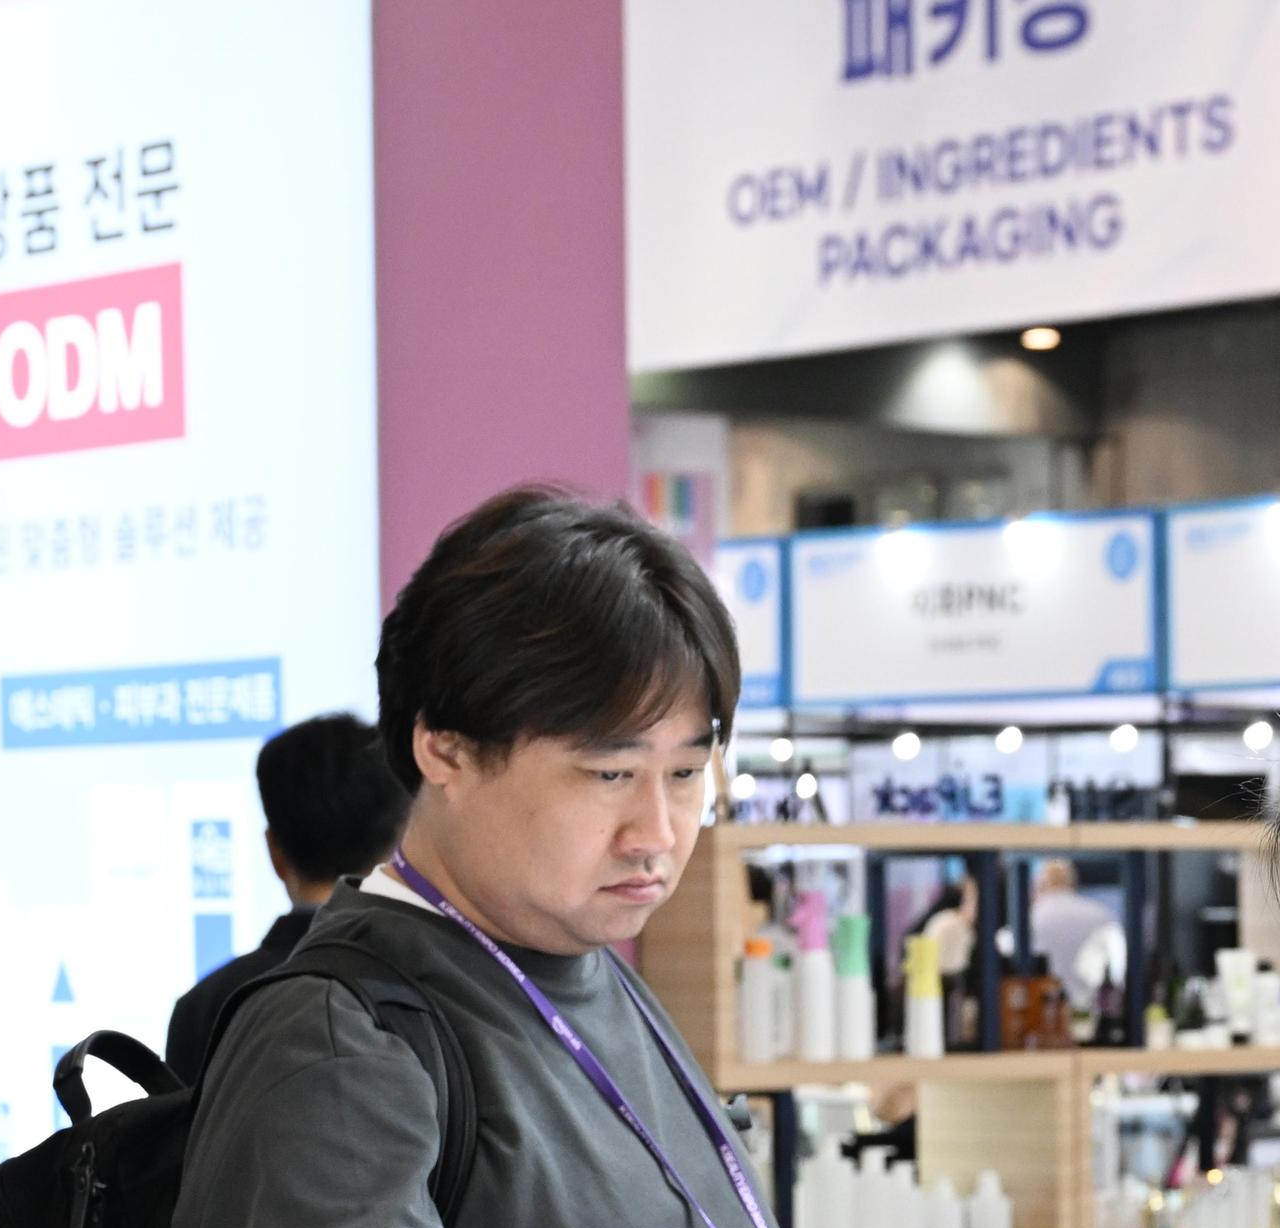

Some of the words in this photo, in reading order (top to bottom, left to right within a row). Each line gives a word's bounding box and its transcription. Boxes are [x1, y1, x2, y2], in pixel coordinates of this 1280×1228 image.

[82, 138, 181, 244] 전문
[725, 163, 830, 227] OEM
[876, 95, 1236, 201] INGREDIENTS
[818, 192, 1123, 286] PACKAGING
